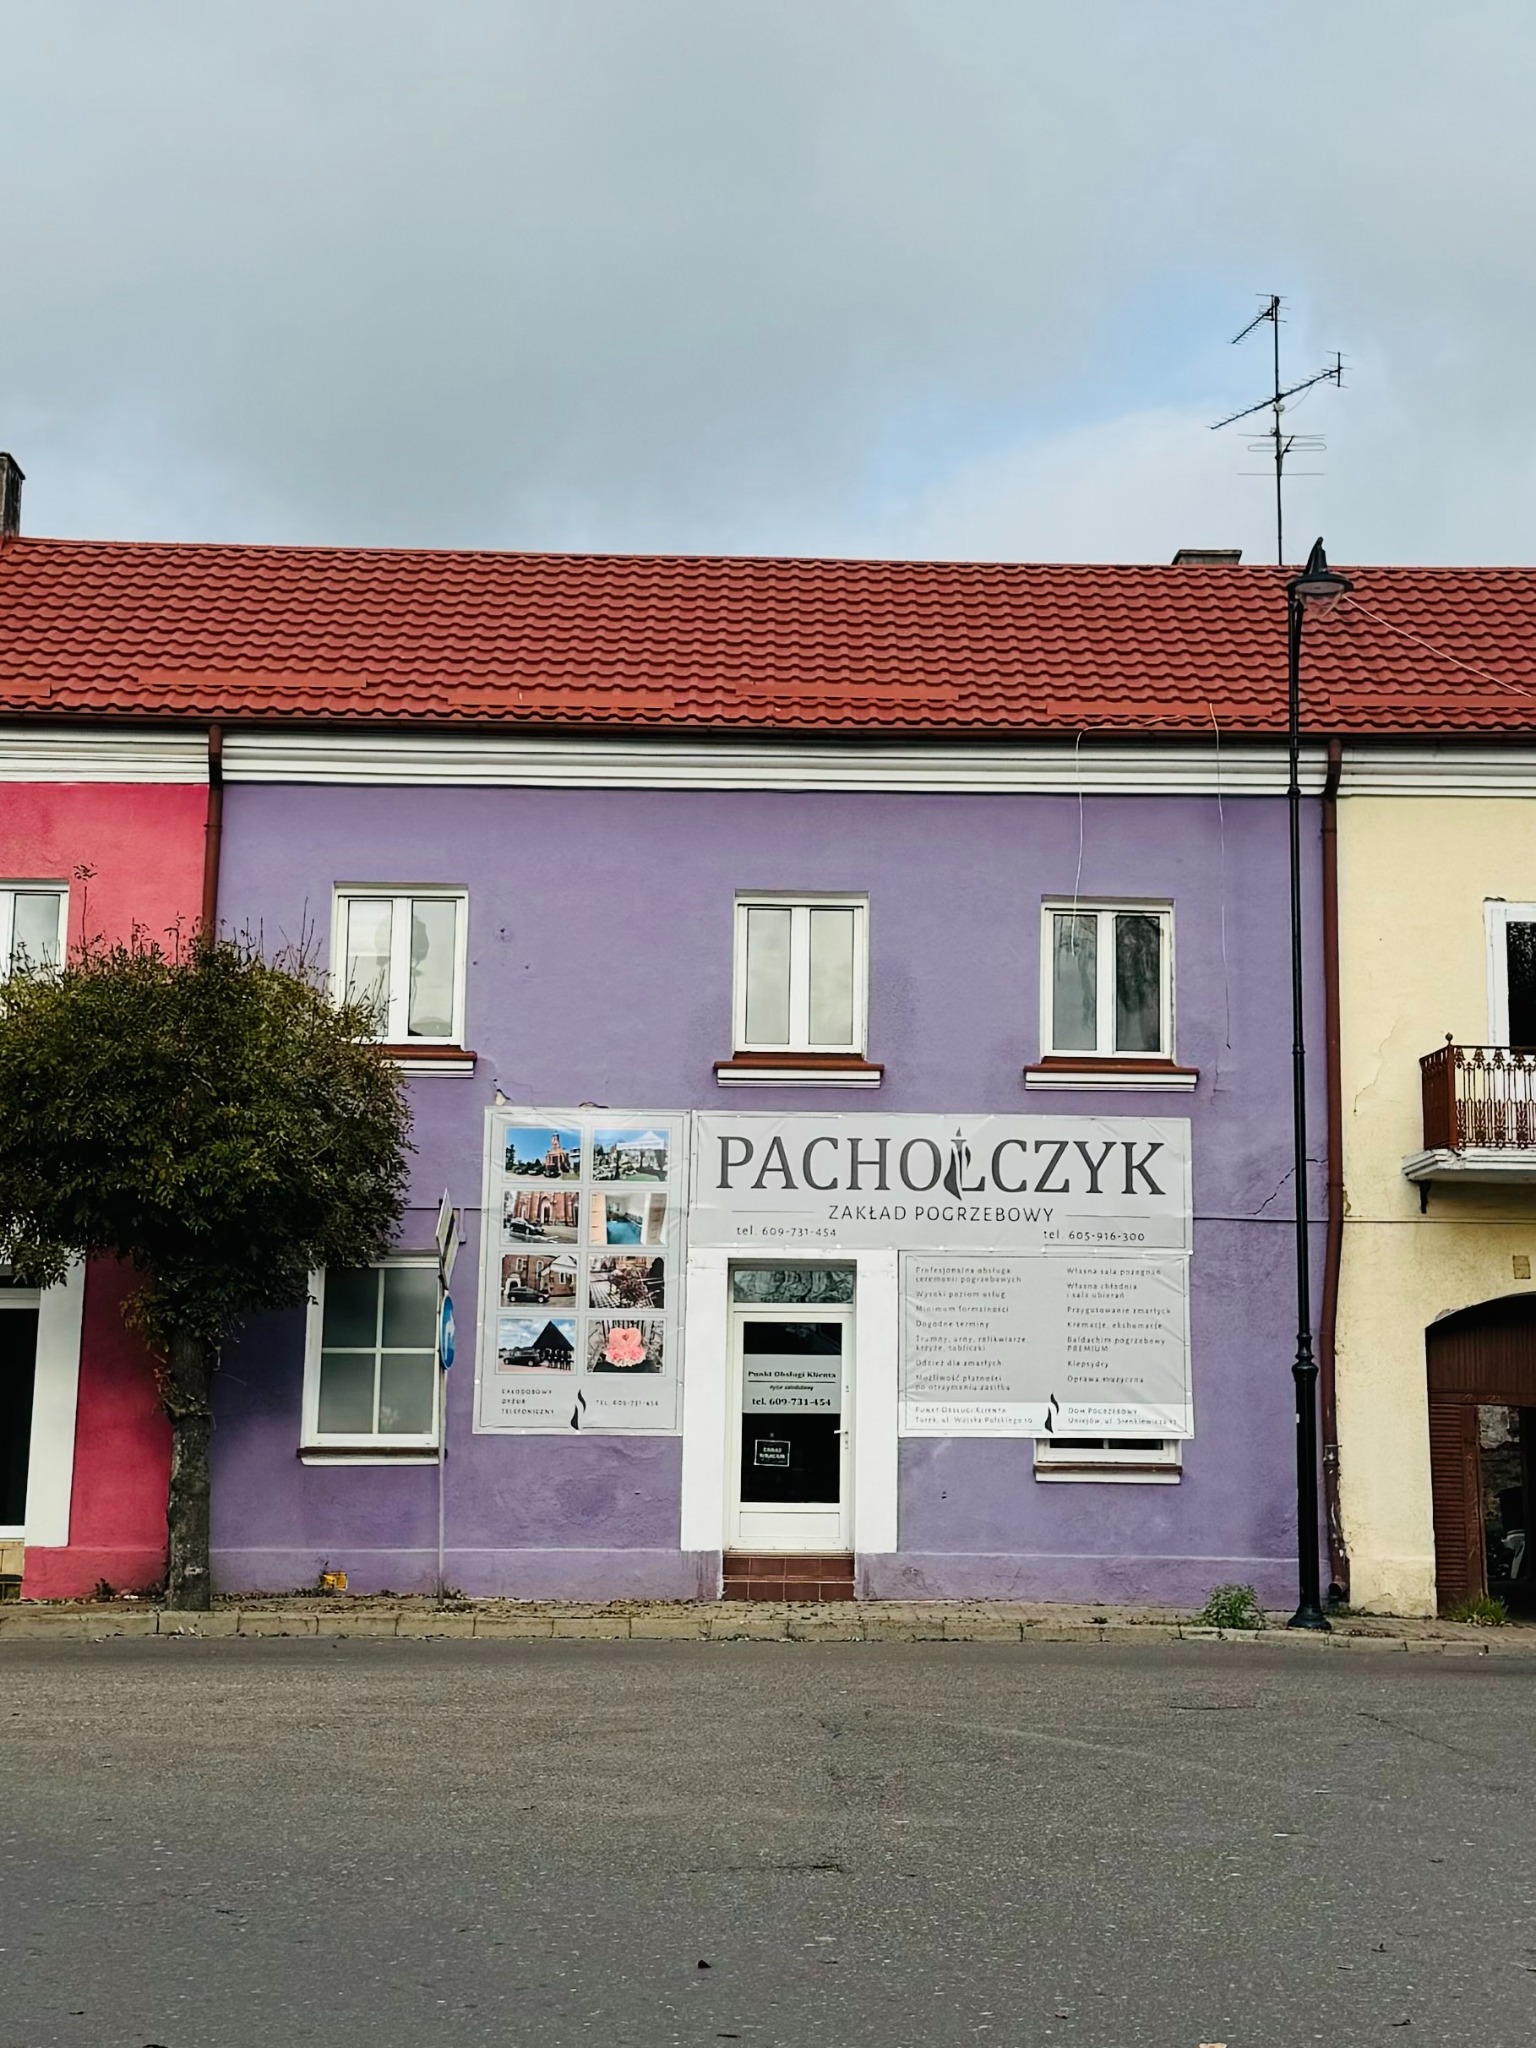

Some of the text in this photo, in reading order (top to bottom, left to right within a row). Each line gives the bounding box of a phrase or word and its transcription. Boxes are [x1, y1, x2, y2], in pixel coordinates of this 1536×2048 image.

[716, 1131, 1166, 1198] PACHOŁCZYK
[829, 1205, 1054, 1222] ZAKŁAD POGRZEBOWY
[762, 1227, 837, 1237] 609-731-454
[1069, 1231, 1145, 1241] 605-916-300
[916, 1266, 975, 1275] Profesjonalna
[915, 1320, 953, 1328] Dogodne
[769, 1398, 831, 1406] 609-731-454
